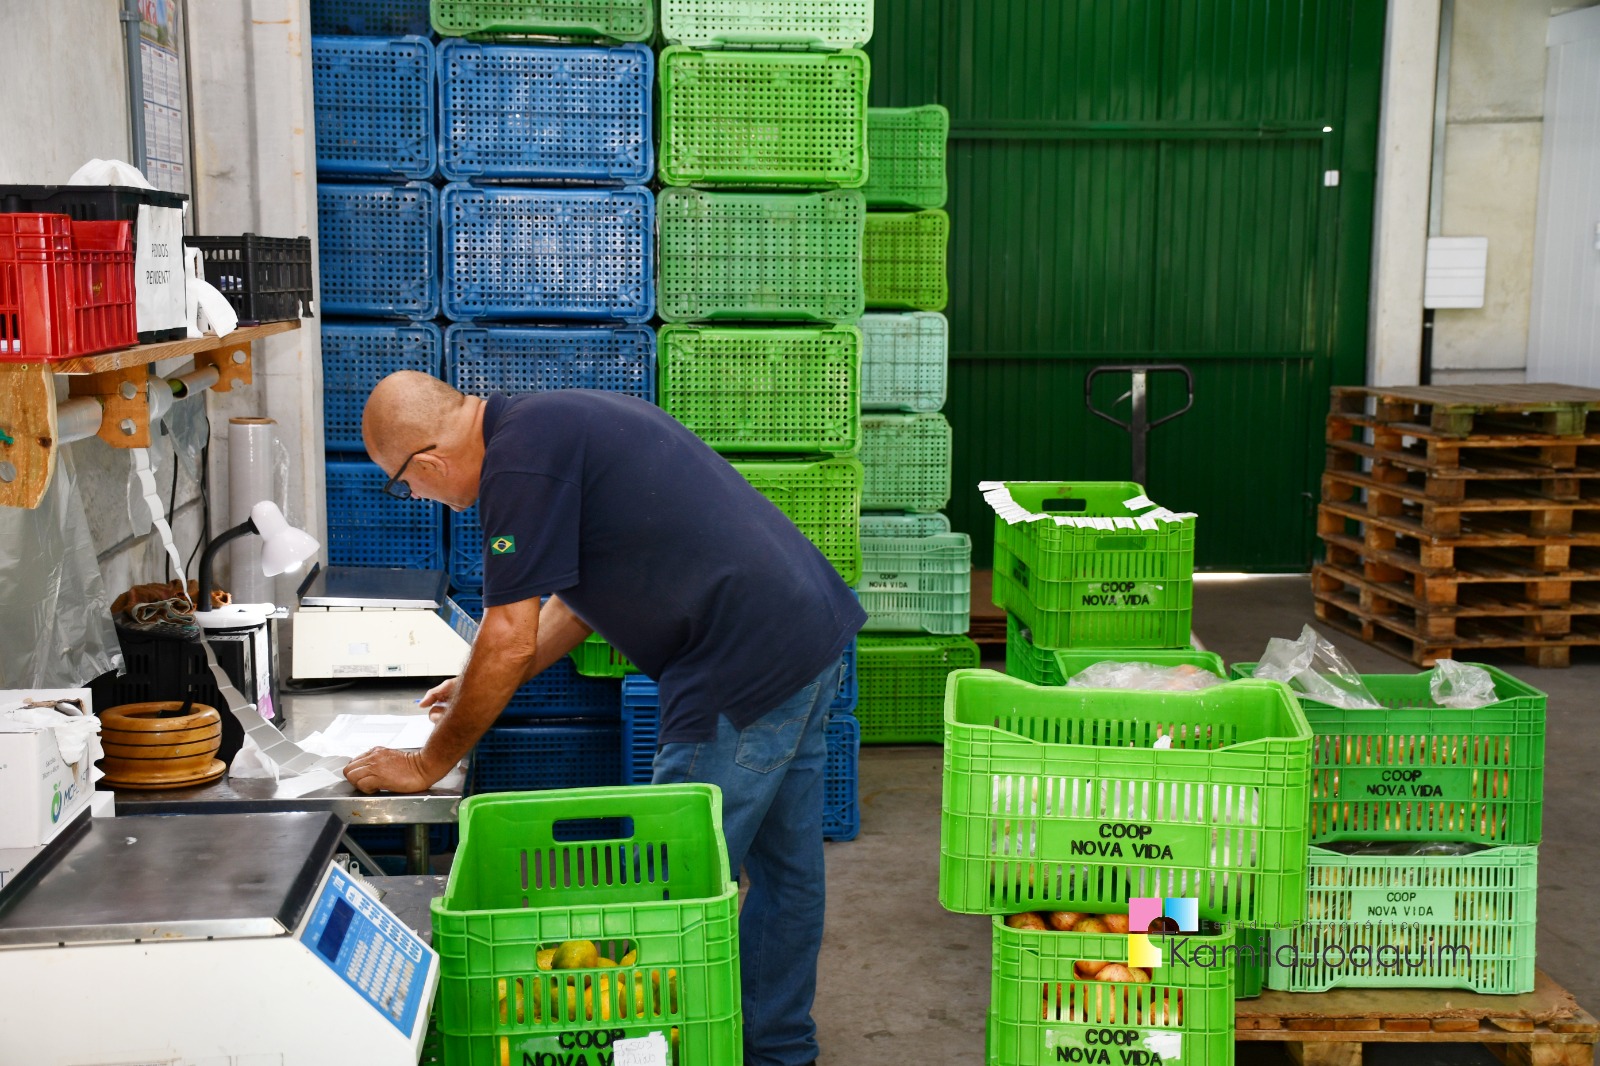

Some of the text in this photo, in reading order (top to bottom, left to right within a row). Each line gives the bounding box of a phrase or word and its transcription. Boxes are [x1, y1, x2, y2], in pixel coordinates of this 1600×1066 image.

[890, 581, 908, 589] VIDA
[1101, 581, 1136, 593] COOP
[1082, 594, 1150, 606] NOVA VIDA
[1381, 770, 1423, 783] COOP
[1366, 784, 1443, 797] NOVA VIDA
[1099, 823, 1153, 840] COOP
[1070, 840, 1174, 860] NOVA VIDA
[1386, 892, 1417, 902] COOP
[1367, 906, 1434, 916] NOVA VIDA
[558, 1028, 626, 1050] COOP
[1085, 1028, 1140, 1046] COOP
[522, 1051, 590, 1066] NOVA
[1056, 1046, 1163, 1066] NOVA VIDA
